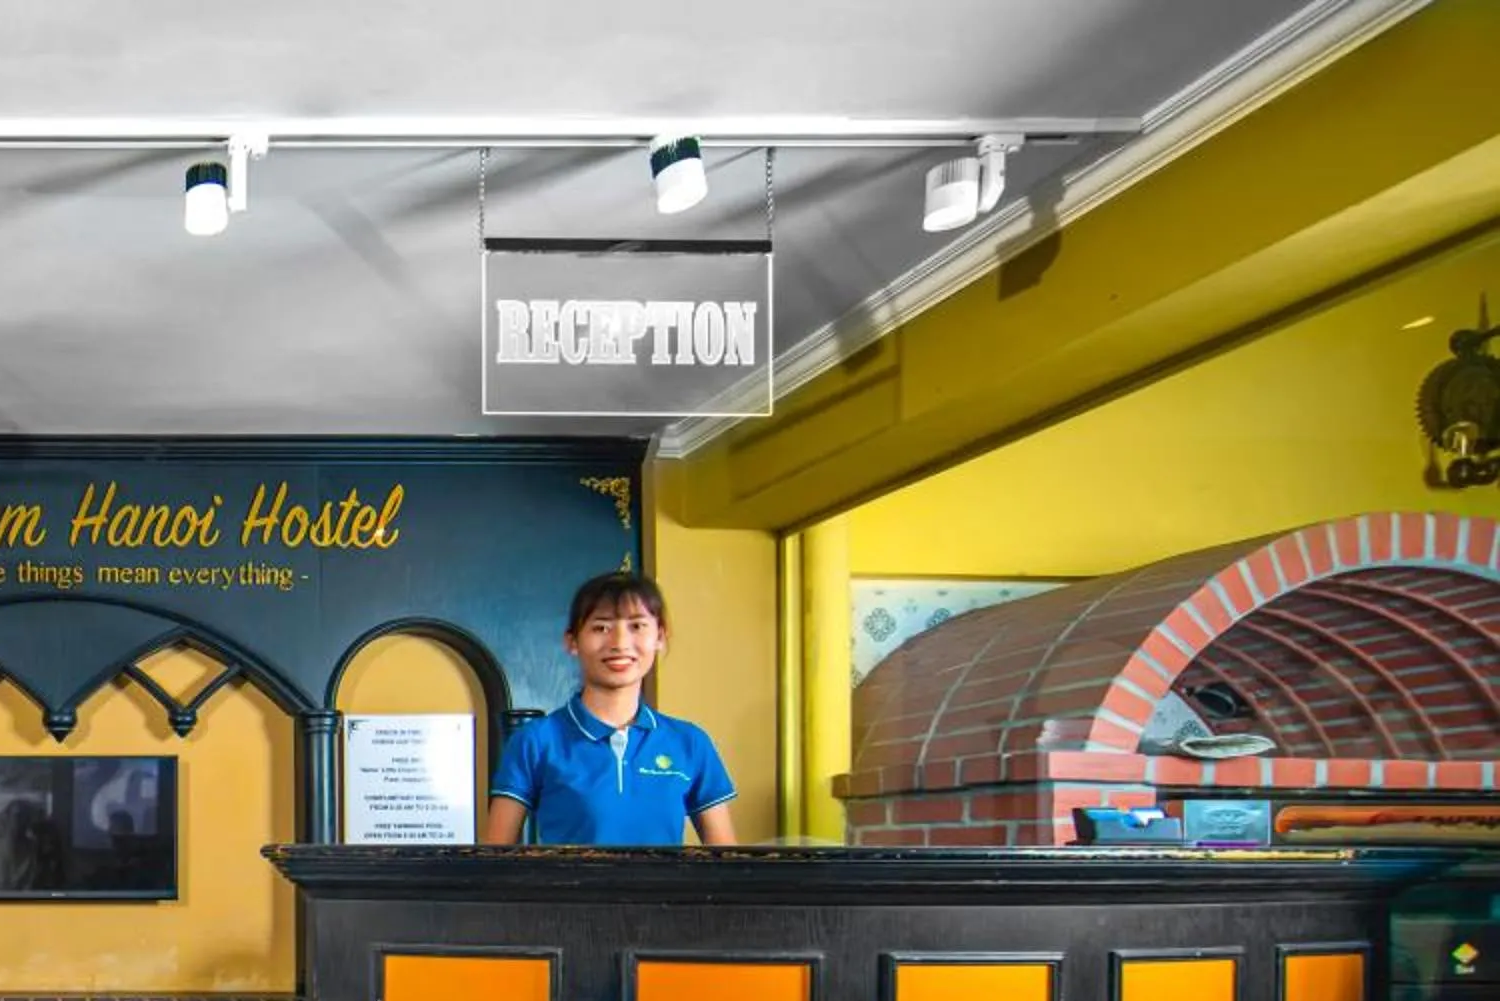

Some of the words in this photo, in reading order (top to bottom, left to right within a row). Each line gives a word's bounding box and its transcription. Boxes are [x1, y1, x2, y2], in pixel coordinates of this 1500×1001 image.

[497, 299, 757, 365] RECEPTION
[70, 480, 224, 548] Hanoi
[240, 480, 405, 549] Hostel
[18, 561, 84, 588] things
[98, 565, 160, 584] mean
